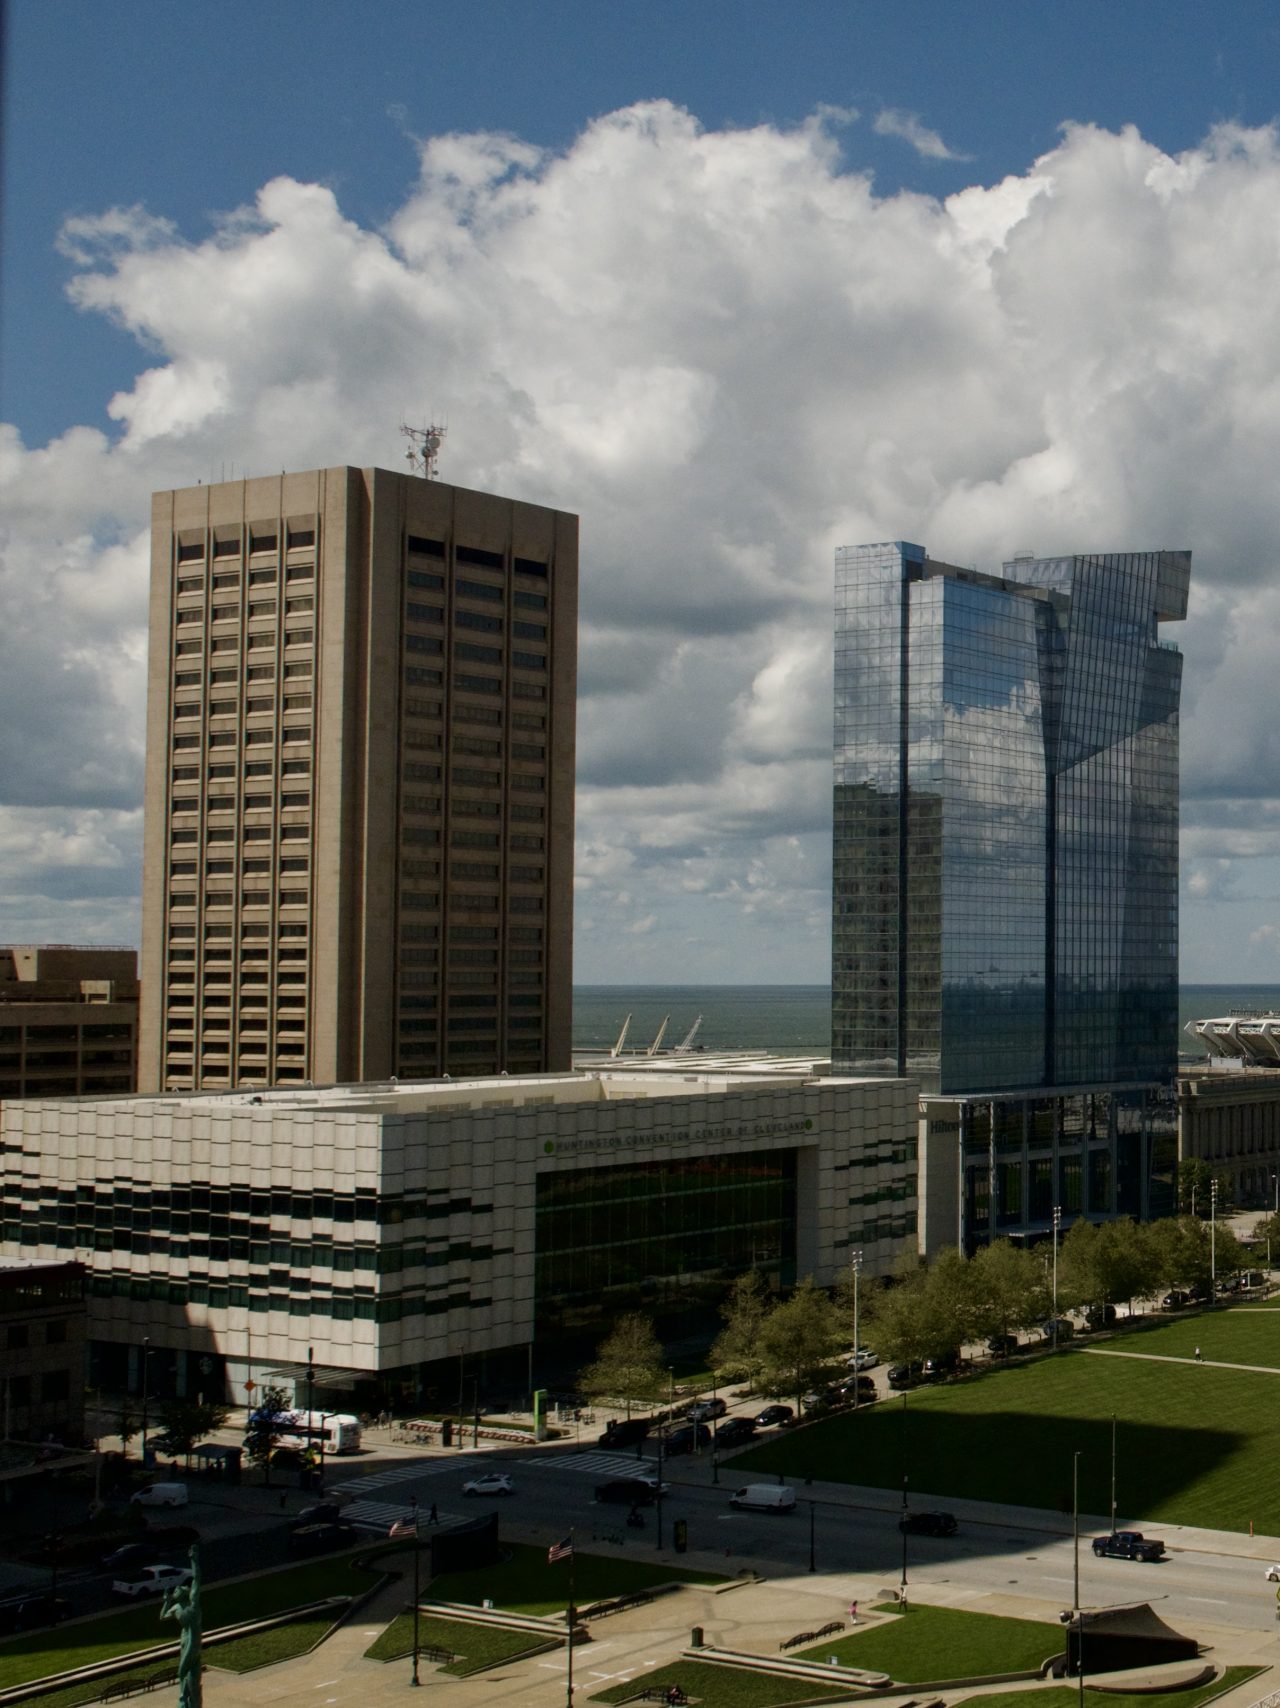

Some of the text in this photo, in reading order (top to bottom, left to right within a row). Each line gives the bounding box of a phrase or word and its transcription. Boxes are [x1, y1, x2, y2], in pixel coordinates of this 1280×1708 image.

[556, 1121, 805, 1152] HUNTINGTON CONVENTION CENTER OF CLEVELAND
[931, 1120, 960, 1134] Hilton
